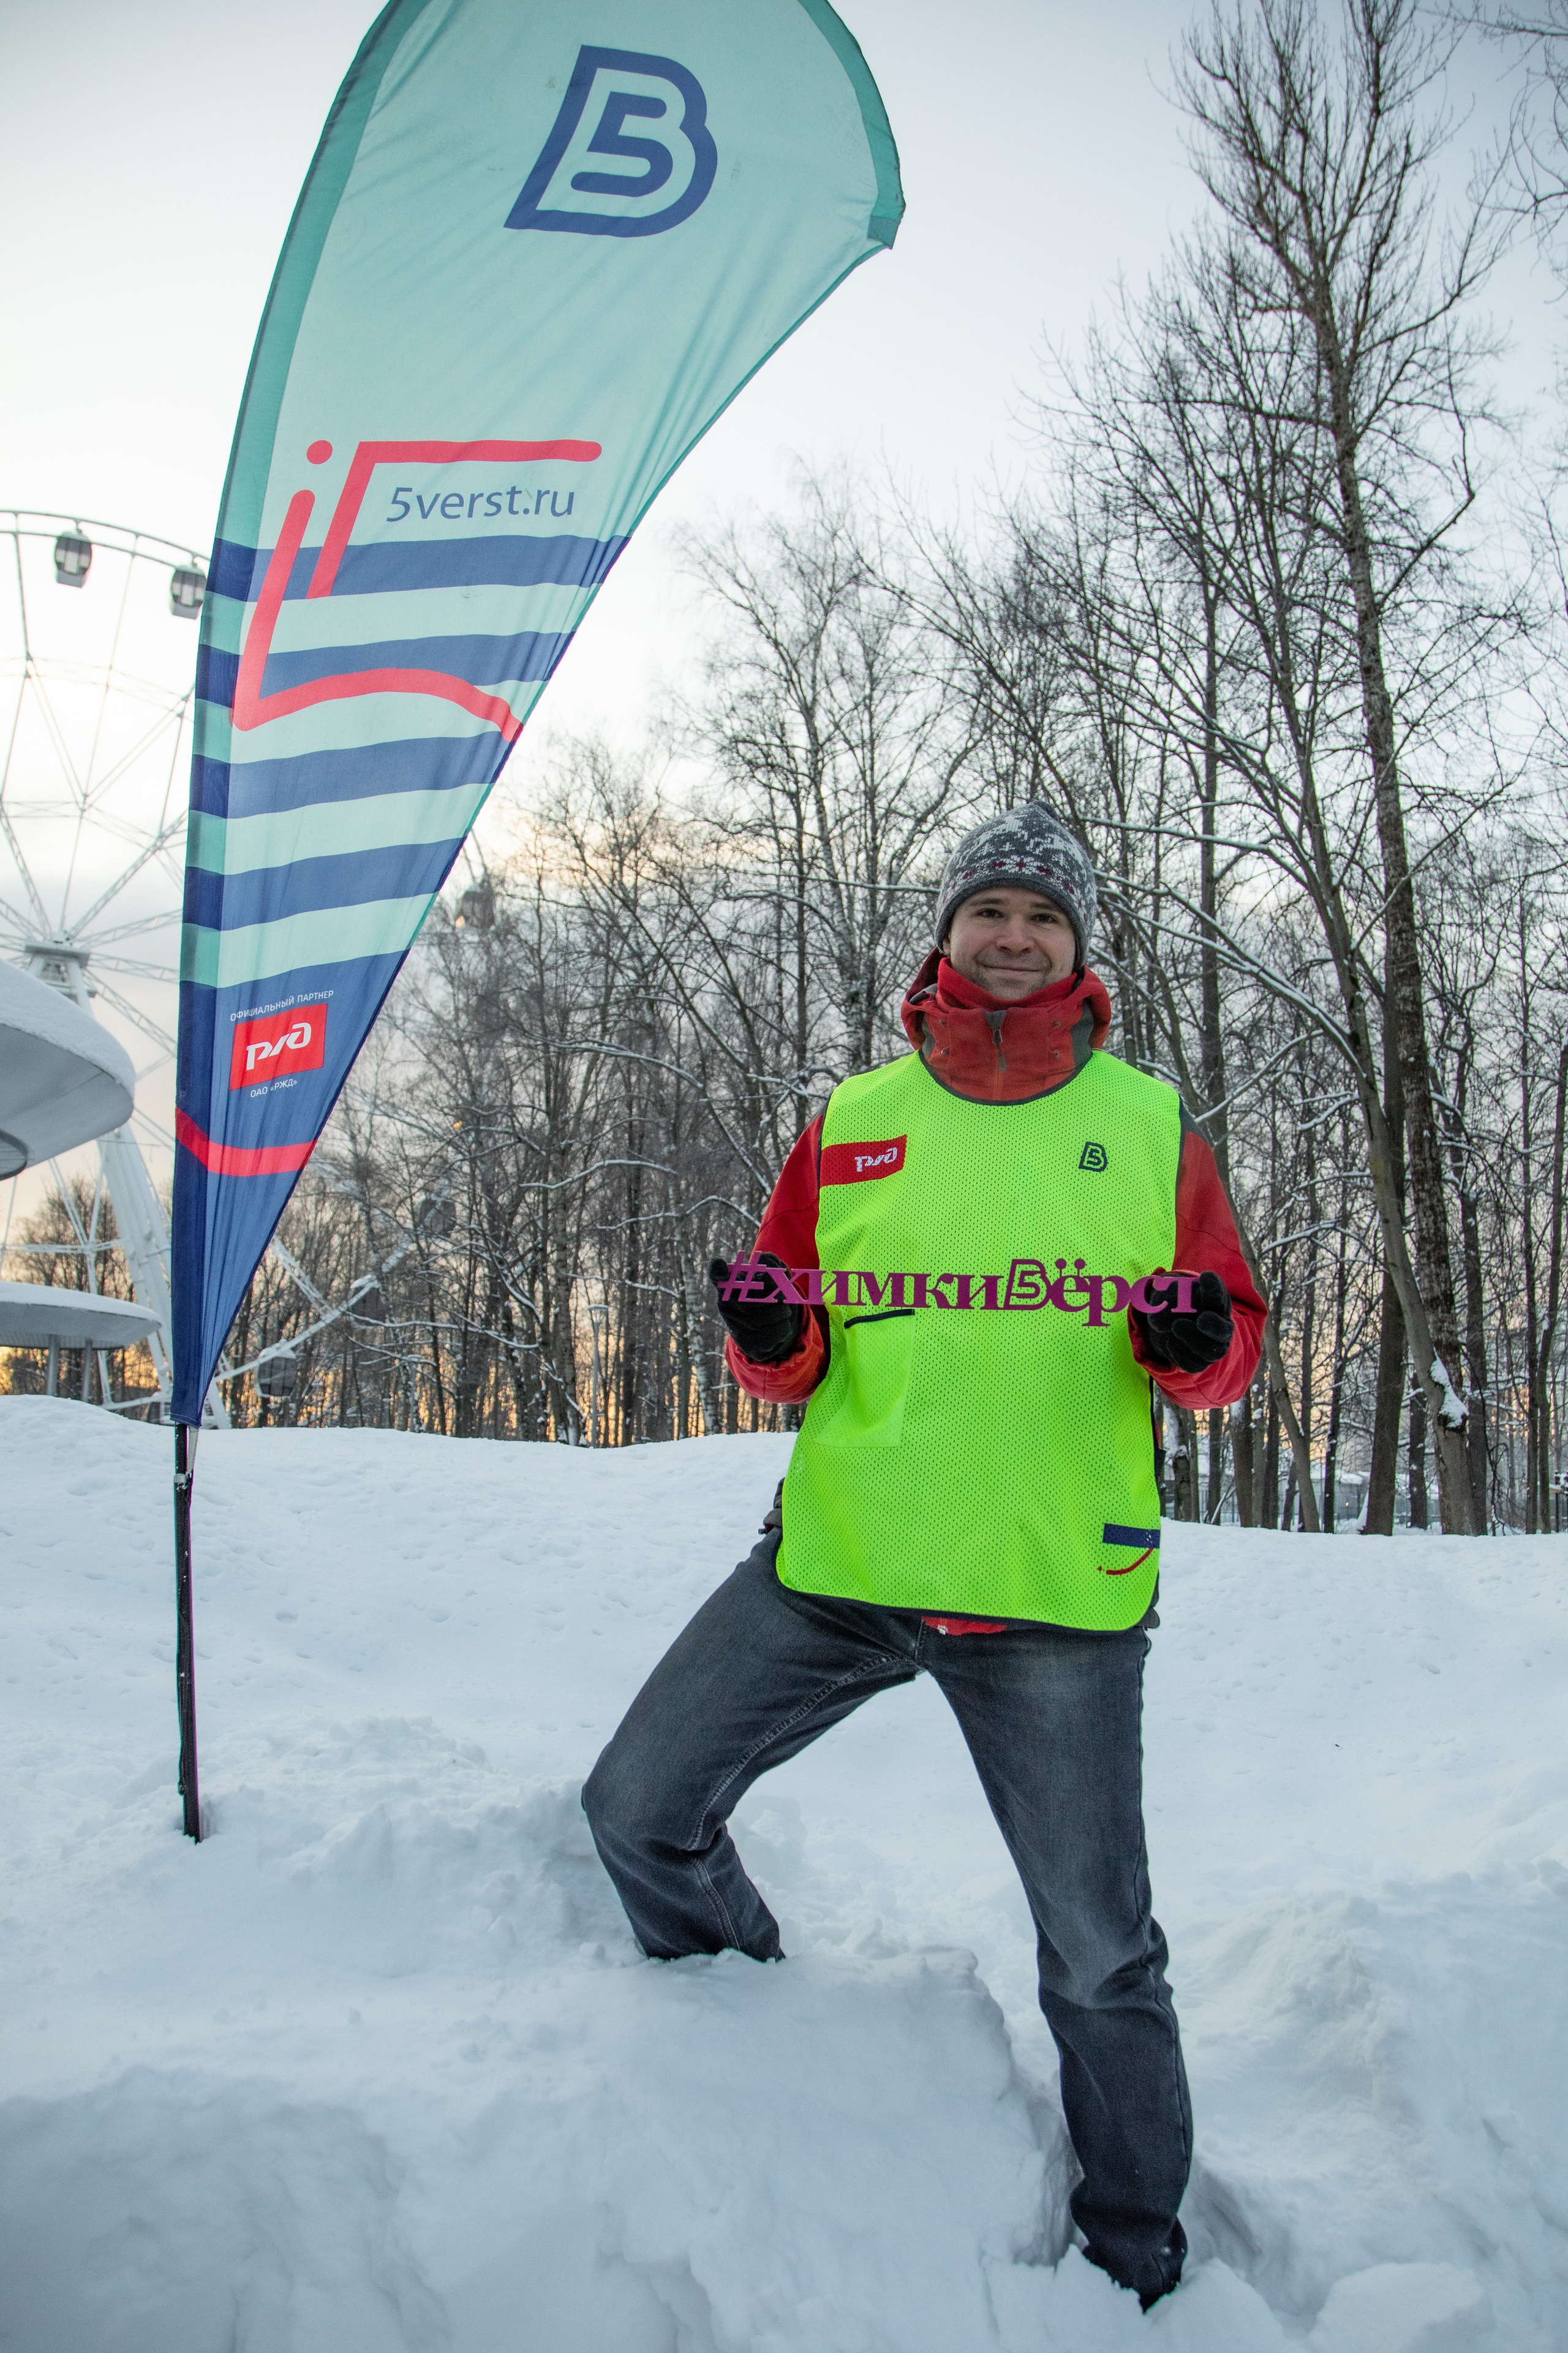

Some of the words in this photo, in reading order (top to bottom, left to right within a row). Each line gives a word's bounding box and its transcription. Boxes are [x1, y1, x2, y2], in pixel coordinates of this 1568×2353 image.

[386, 485, 575, 522] 5verst.ru
[230, 995, 294, 1021] ОФИЦИАЛЬНЫЙ
[297, 990, 334, 1003] ПАРТНЕР
[250, 1086, 268, 1098] ОАО
